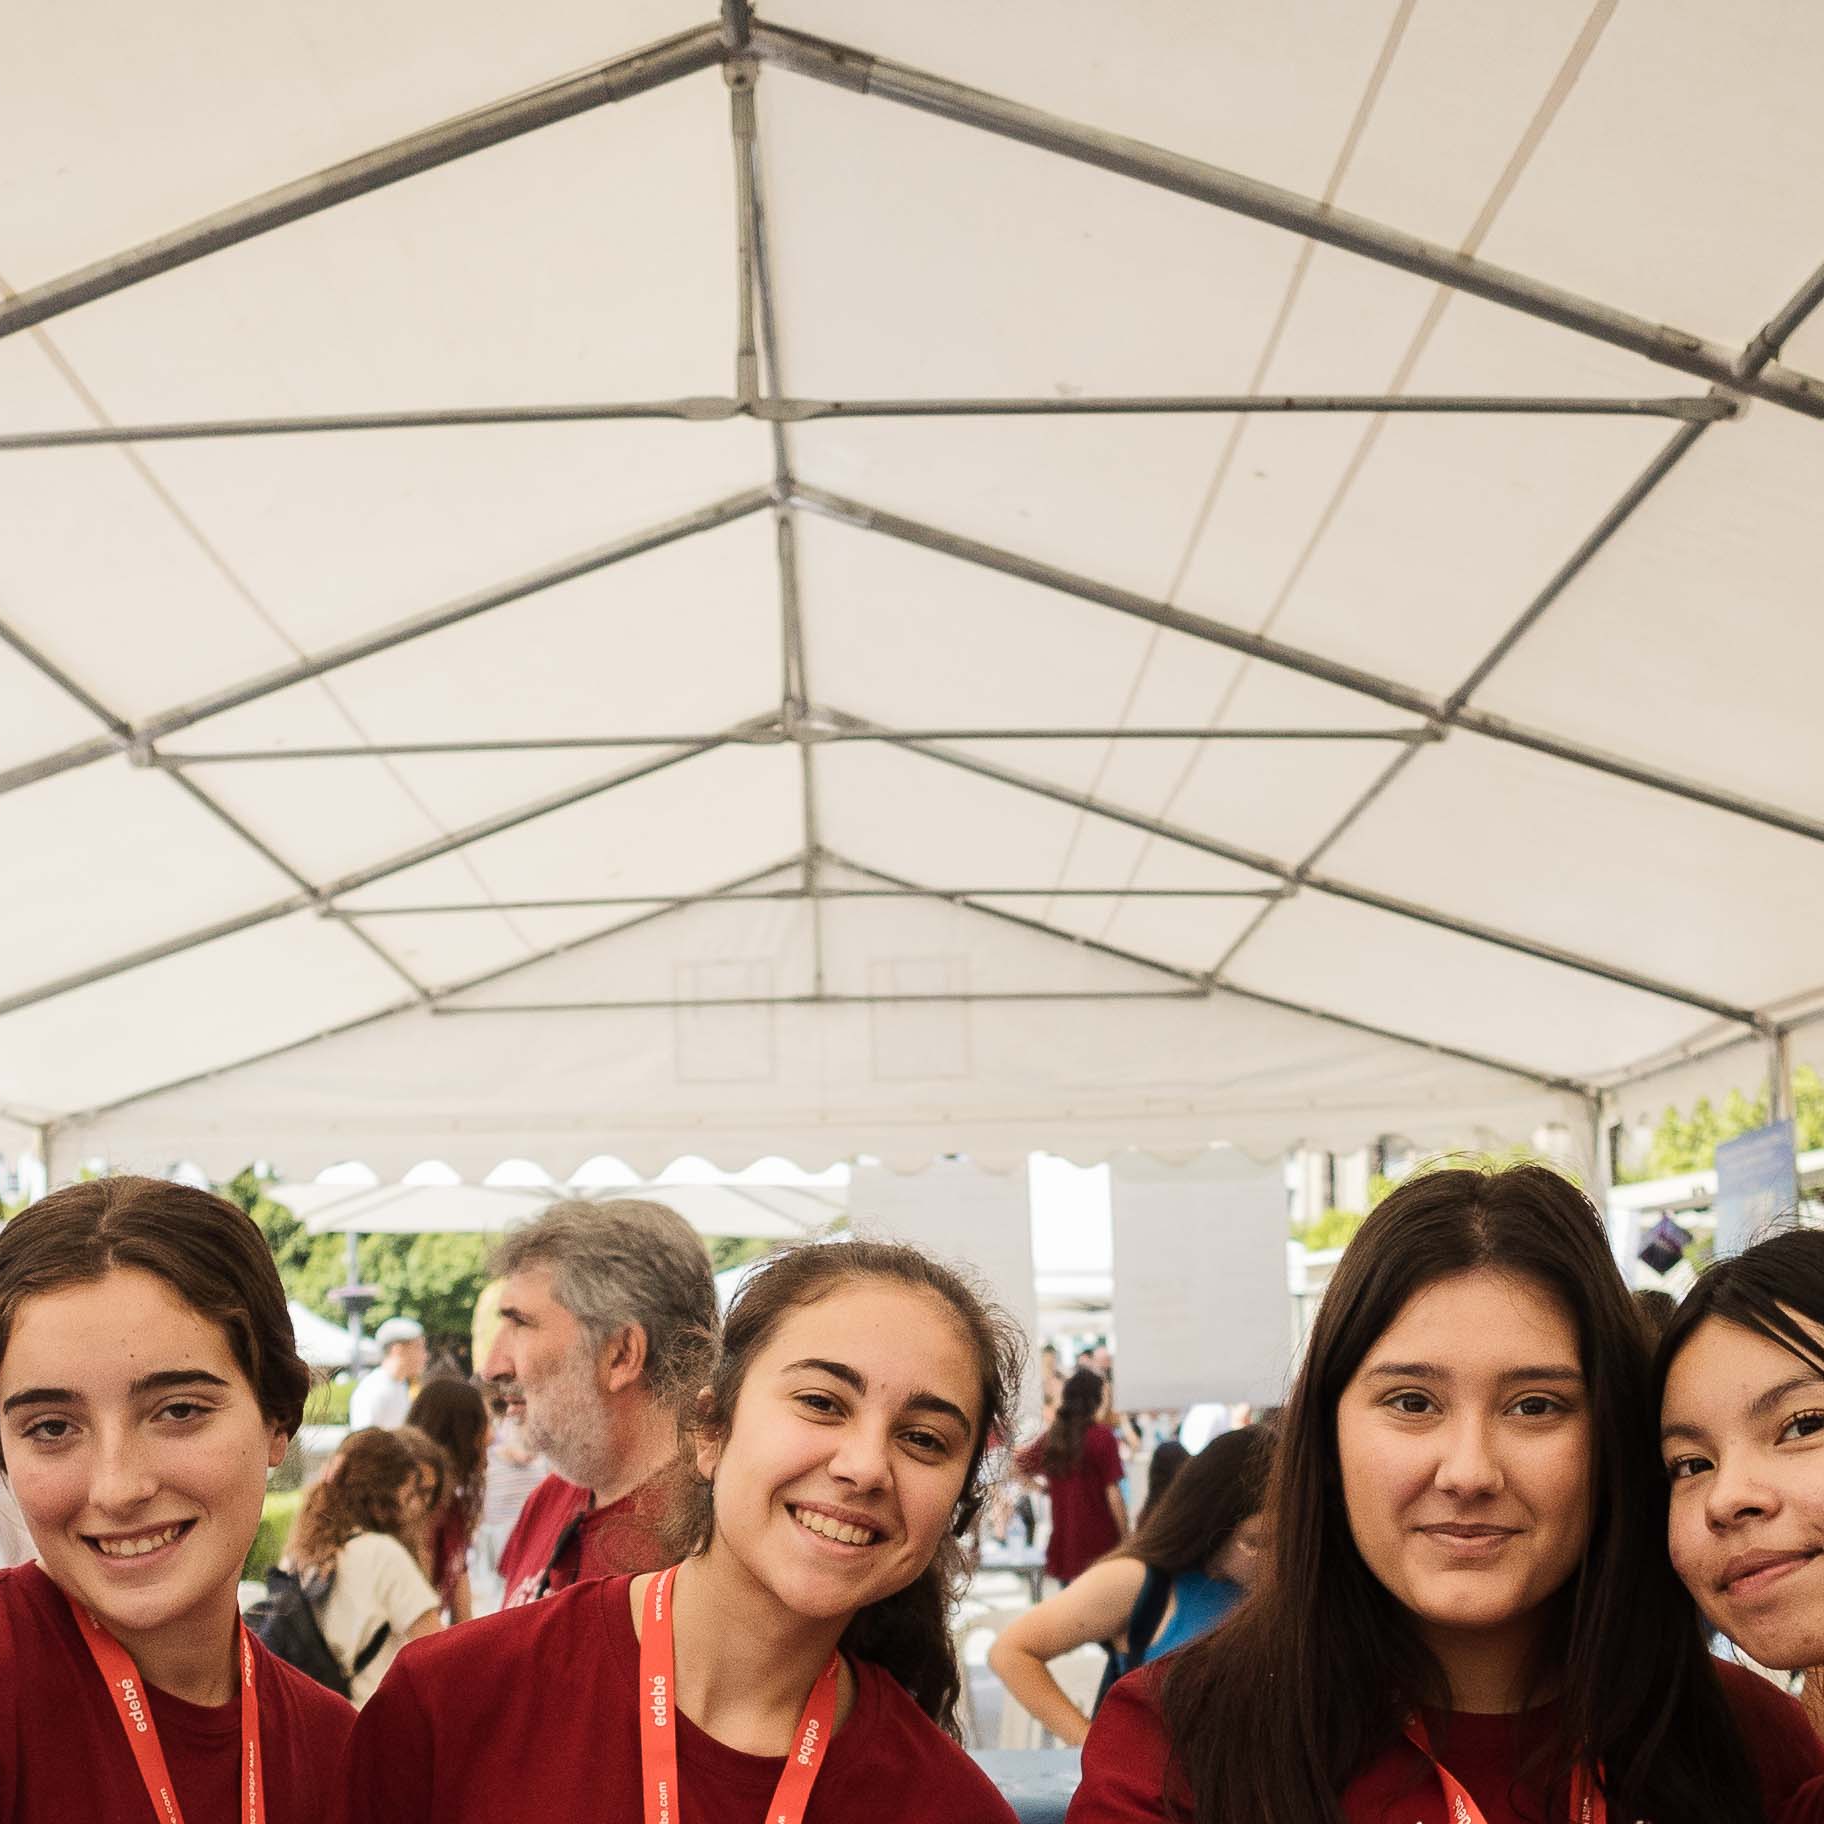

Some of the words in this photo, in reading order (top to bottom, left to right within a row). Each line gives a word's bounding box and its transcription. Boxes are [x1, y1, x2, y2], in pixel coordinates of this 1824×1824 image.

[116, 1678, 147, 1733] edebé
[653, 1674, 666, 1727] edebé
[797, 1718, 820, 1766] edebé
